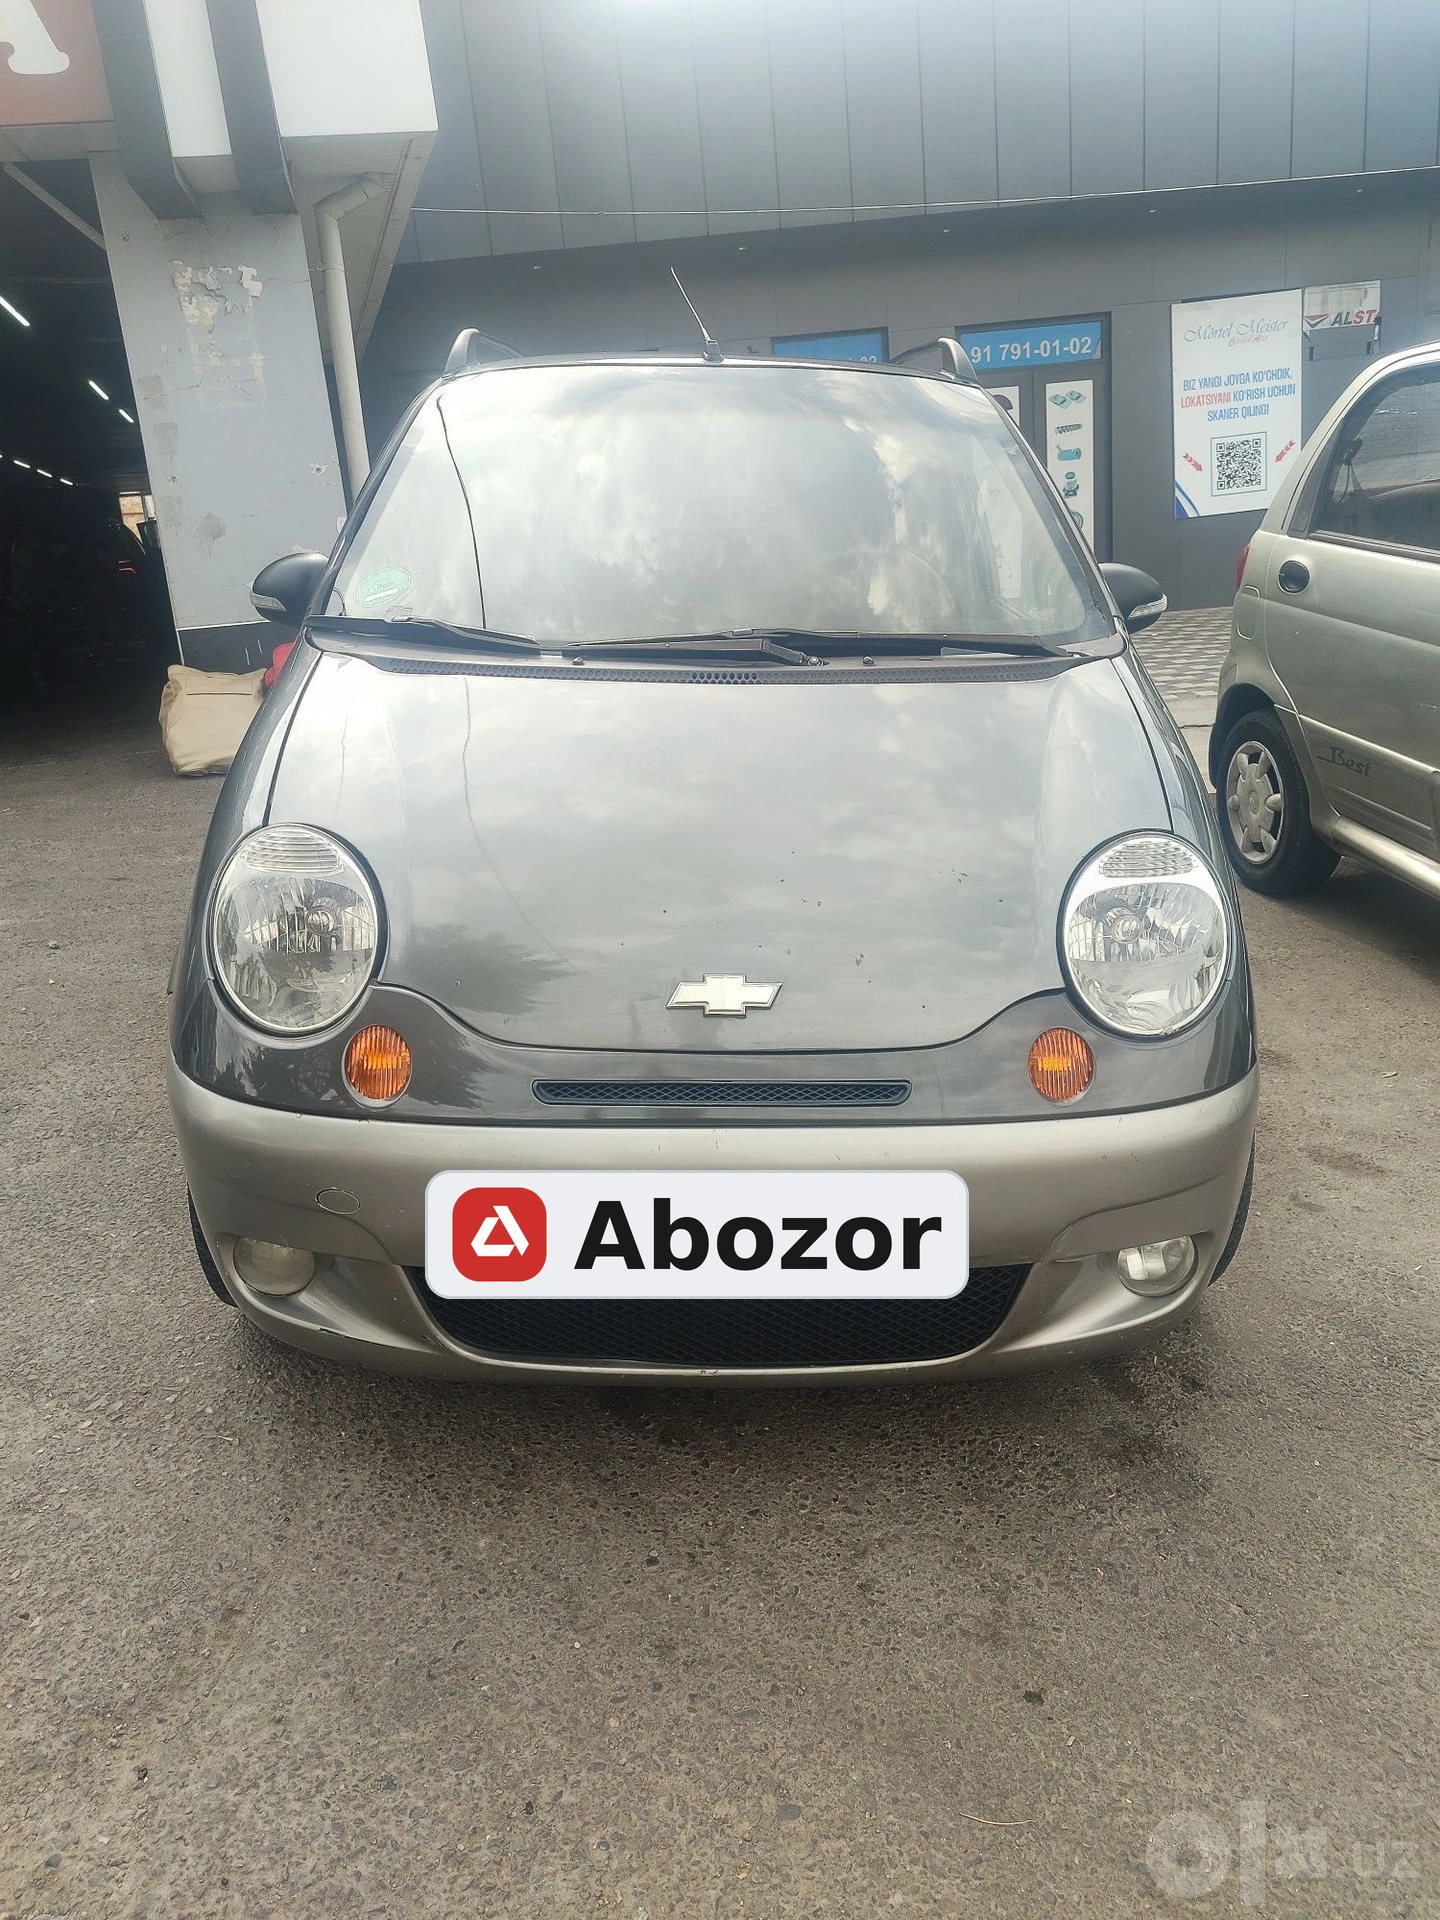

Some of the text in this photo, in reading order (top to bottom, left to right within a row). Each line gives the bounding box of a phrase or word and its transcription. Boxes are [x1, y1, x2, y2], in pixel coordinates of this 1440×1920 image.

[1236, 318, 1288, 335] Meister
[970, 336, 1092, 364] 91 791-01-02
[1183, 379, 1196, 392] BIZ
[1198, 376, 1222, 389] YANGI
[1224, 372, 1250, 387] JOYGA
[1181, 383, 1296, 408] LOKATSIYANI KO'RISH UCHUN
[1207, 407, 1240, 422] SKANER
[1319, 745, 1371, 778] Best
